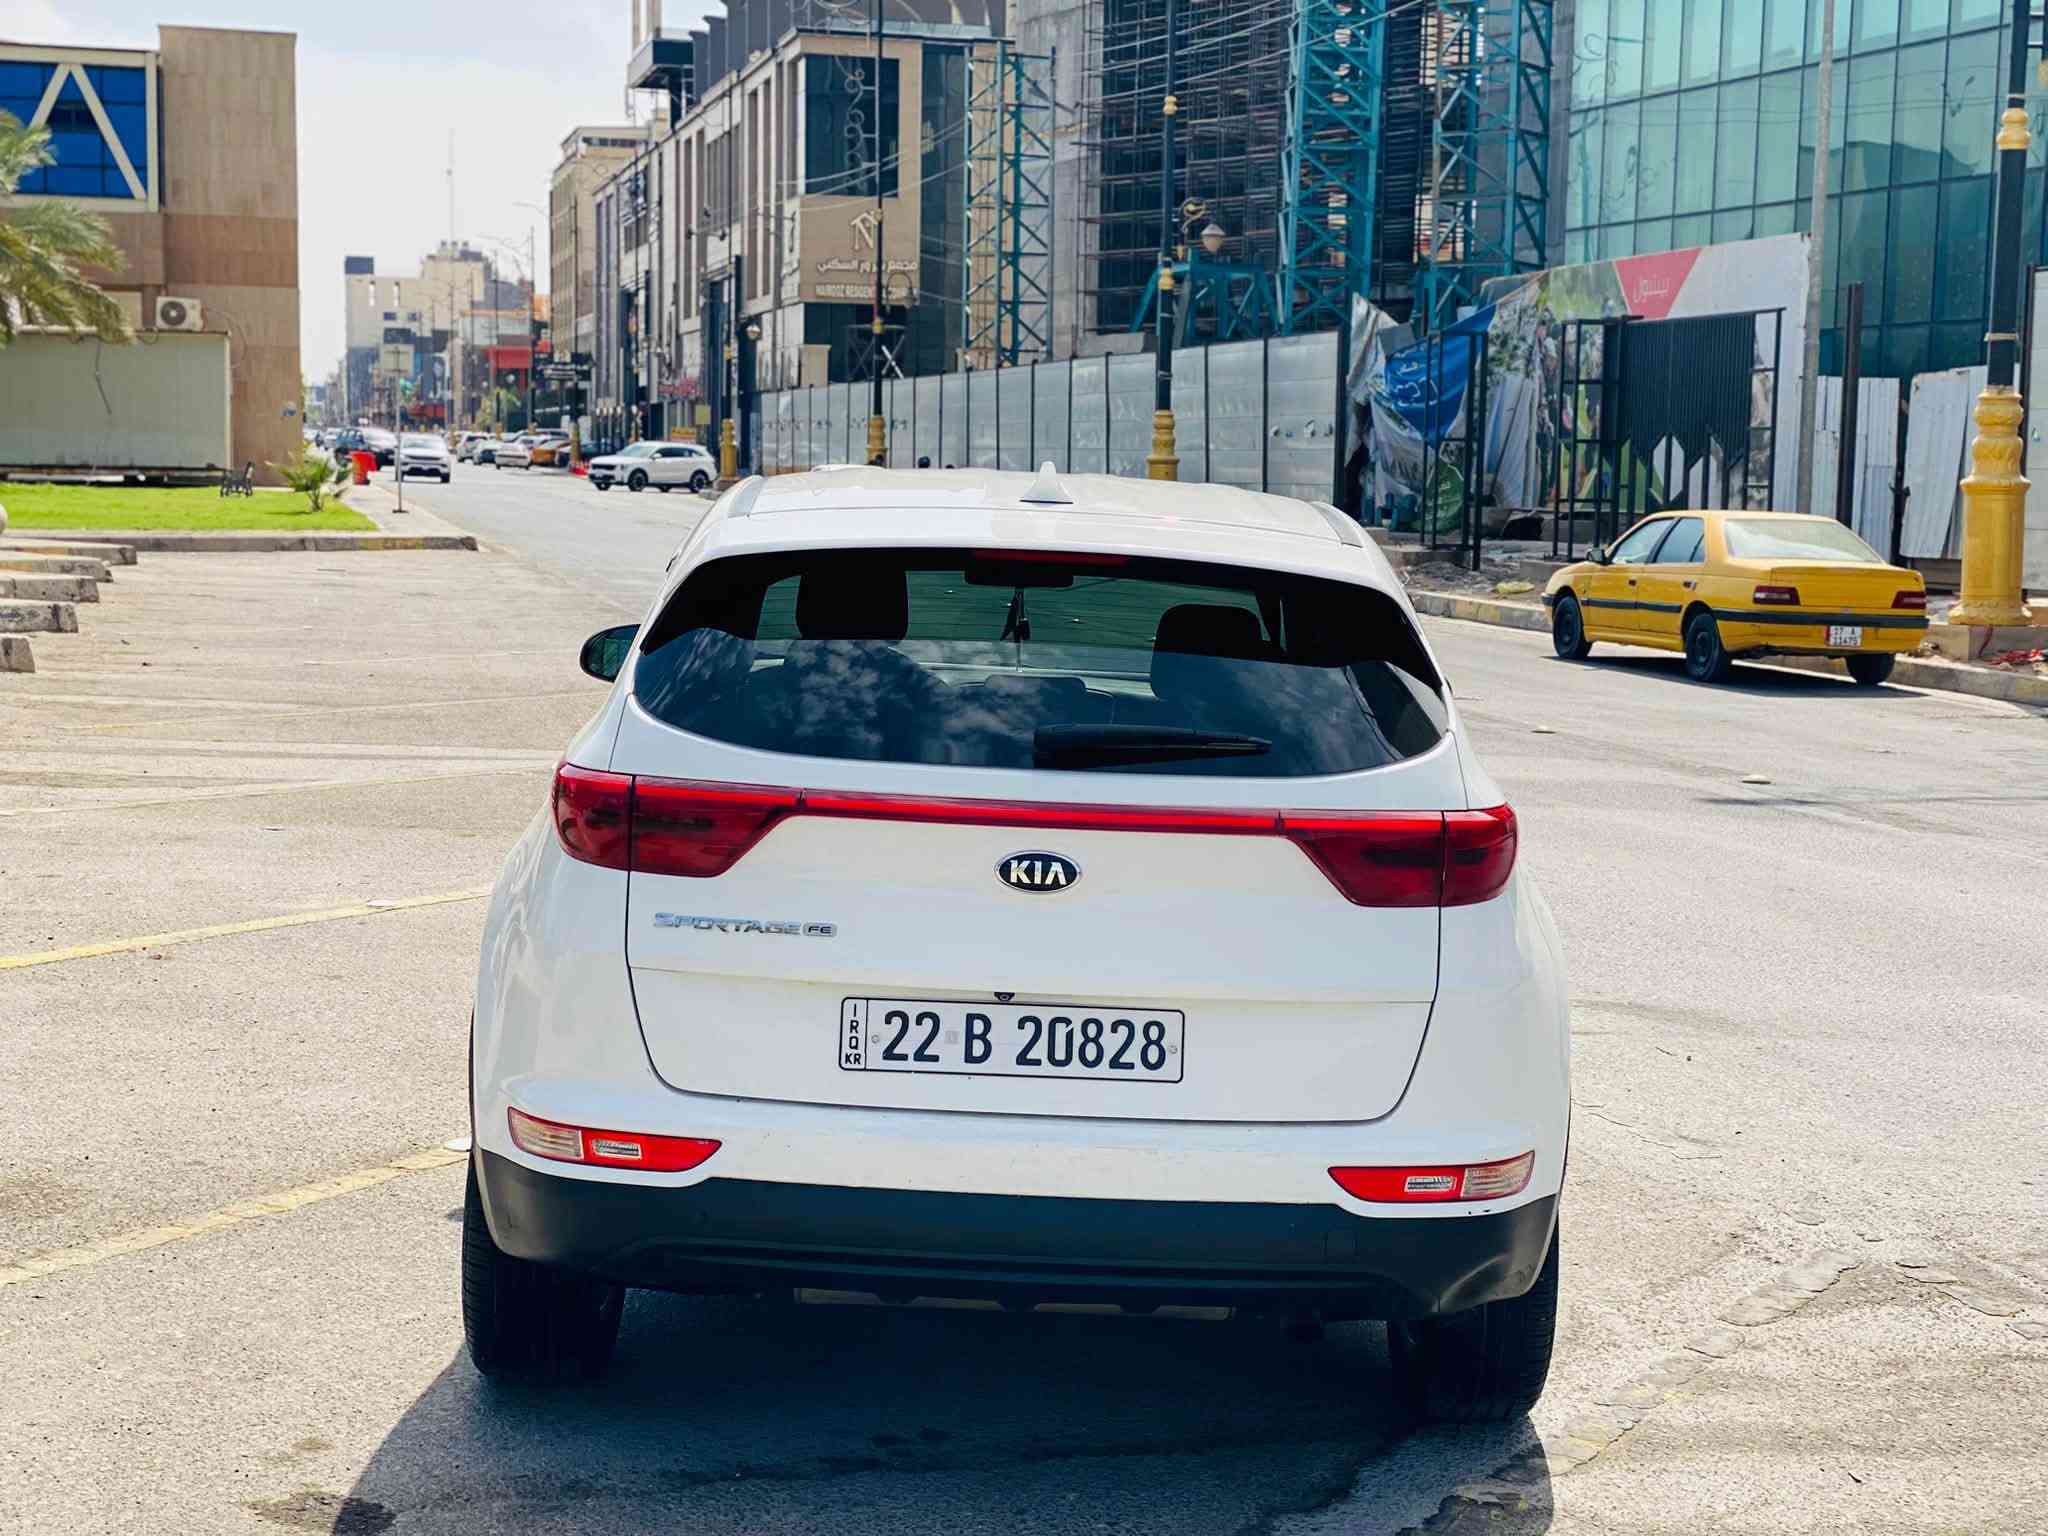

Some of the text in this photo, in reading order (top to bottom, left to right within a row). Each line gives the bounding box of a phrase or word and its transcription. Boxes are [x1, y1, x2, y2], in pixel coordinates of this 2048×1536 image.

[1008, 859, 1067, 885] KIA
[654, 911, 834, 936] SPORTAGE FE
[882, 1009, 1167, 1071] 22 B 20828
[844, 1053, 861, 1065] KR
